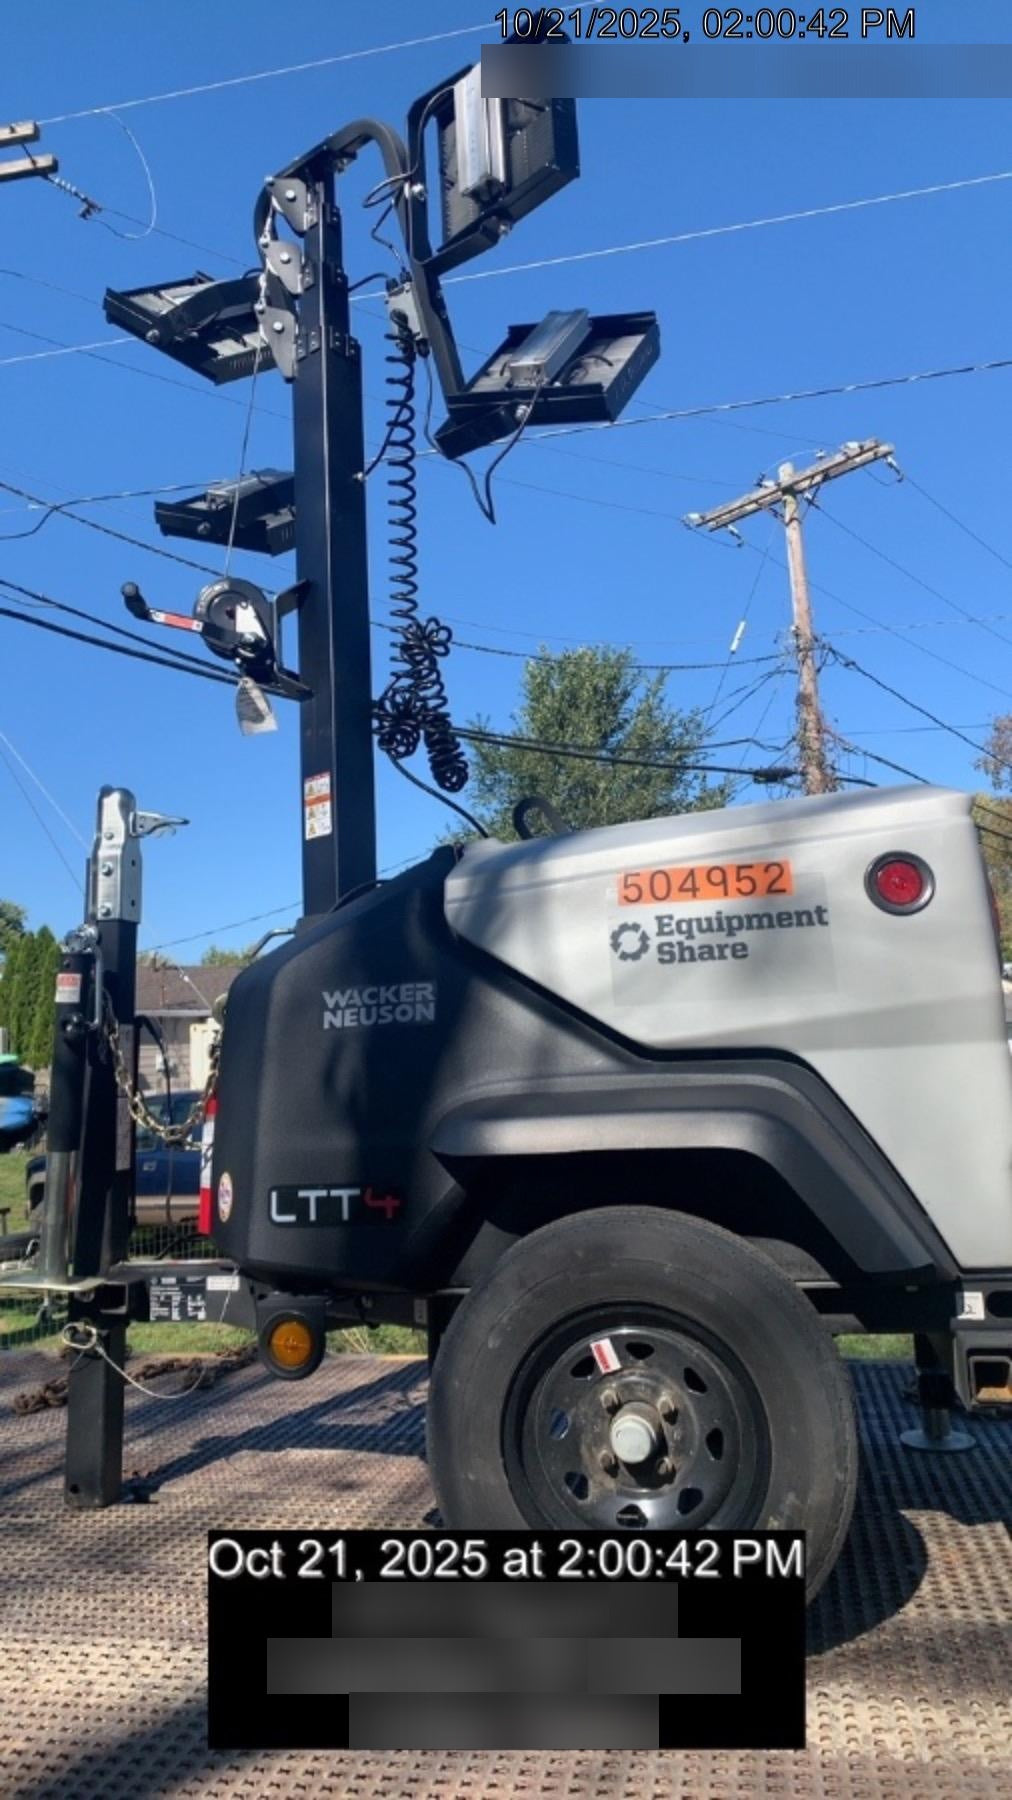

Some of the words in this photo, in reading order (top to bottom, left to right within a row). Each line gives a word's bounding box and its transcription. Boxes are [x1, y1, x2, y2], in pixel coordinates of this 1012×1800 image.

[622, 862, 788, 904] 504952
[654, 904, 829, 940] Equipment
[656, 940, 749, 965] Share
[321, 982, 436, 1009] WACKER
[323, 1002, 435, 1030] NEUSON
